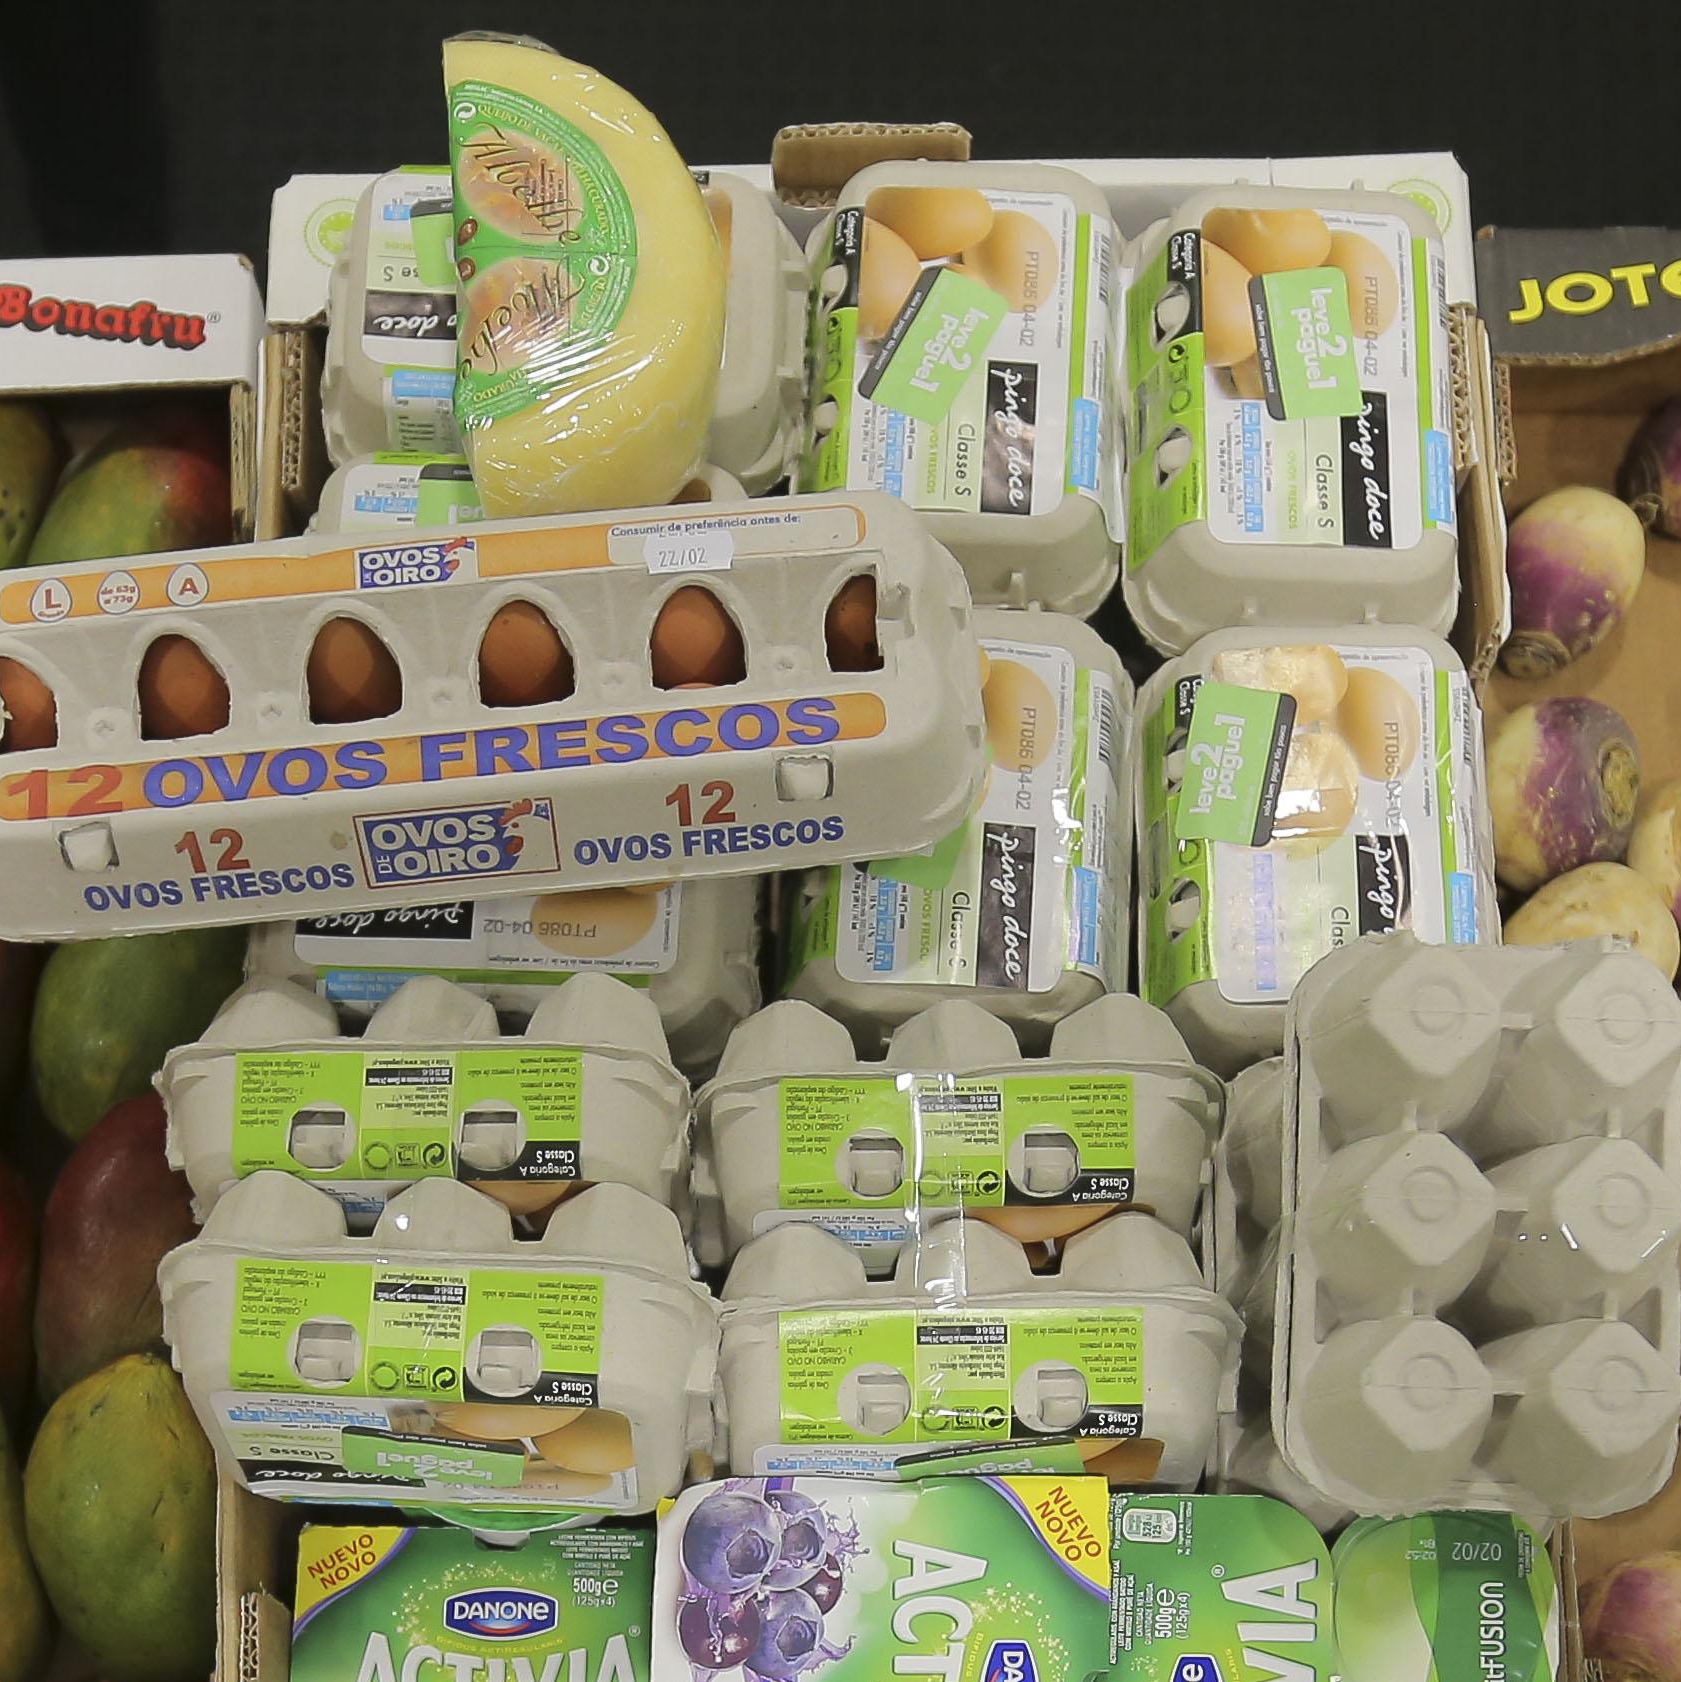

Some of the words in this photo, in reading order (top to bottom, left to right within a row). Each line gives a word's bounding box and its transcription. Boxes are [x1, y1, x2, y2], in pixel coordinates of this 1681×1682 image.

[1184, 232, 1197, 270] Categoria
[373, 314, 439, 337] doce
[1018, 303, 1038, 348] 04-02
[1363, 329, 1379, 377] 04-02
[989, 369, 1027, 441] pingo
[954, 423, 976, 480] Classe
[925, 451, 937, 495] FRESCOS
[1006, 442, 1029, 508] doce
[1314, 454, 1334, 511] Classe
[954, 485, 972, 497] S
[1287, 483, 1299, 530] FRESCOS
[1317, 516, 1335, 529] S
[1364, 477, 1388, 541] doce
[610, 524, 664, 538] Consumir
[665, 522, 681, 534] de
[683, 515, 749, 534] preferência
[750, 514, 780, 528] antes
[361, 547, 441, 570] OVOS
[658, 546, 709, 569] 22/02
[178, 577, 199, 596] A
[371, 565, 442, 586] OIRO
[44, 588, 62, 609] L
[3, 763, 125, 820] 12
[143, 742, 388, 808] OVOS
[421, 698, 842, 783] FRESCOS
[664, 779, 738, 828] 12
[1015, 764, 1034, 812] 04-02
[367, 815, 492, 852] OVOS
[573, 832, 673, 867] OVOS
[679, 815, 845, 855] FRESCOS
[172, 826, 252, 876] 12
[392, 839, 503, 878] OIRO
[985, 833, 1023, 907] pingo
[1358, 843, 1397, 919] pingo
[84, 878, 186, 914] OVOS
[190, 861, 353, 904] FRESCOS
[383, 901, 464, 928] pingo
[921, 889, 933, 920] OVOS
[312, 912, 375, 936] doce
[483, 918, 533, 937] 04-02
[947, 891, 970, 951] Classe
[1329, 906, 1351, 949] Clas
[1002, 917, 1028, 982] doce
[528, 1164, 576, 1177] Categoria
[536, 1150, 543, 1163] S
[544, 1150, 575, 1164] Classe
[1080, 1188, 1128, 1202] Categoria
[1090, 1177, 1098, 1190] S
[1098, 1176, 1129, 1190] Classe
[543, 1393, 594, 1406] Categoria
[552, 1381, 560, 1395] S
[561, 1381, 593, 1396] Classe
[1088, 1423, 1137, 1436] Categoria
[1098, 1413, 1106, 1426] S
[1106, 1412, 1138, 1426] Classe
[269, 1446, 336, 1461] Classe
[255, 1468, 323, 1484] doce
[1034, 1498, 1082, 1562] NOVO
[1048, 1484, 1102, 1558] NUEVO
[306, 1533, 376, 1579] NUEVO
[1450, 1542, 1502, 1561] 02/02
[318, 1548, 378, 1592] NOVO
[452, 1600, 549, 1623] DANONE
[1154, 1606, 1174, 1638] 500g
[1176, 1591, 1191, 1640] (125gx4)
